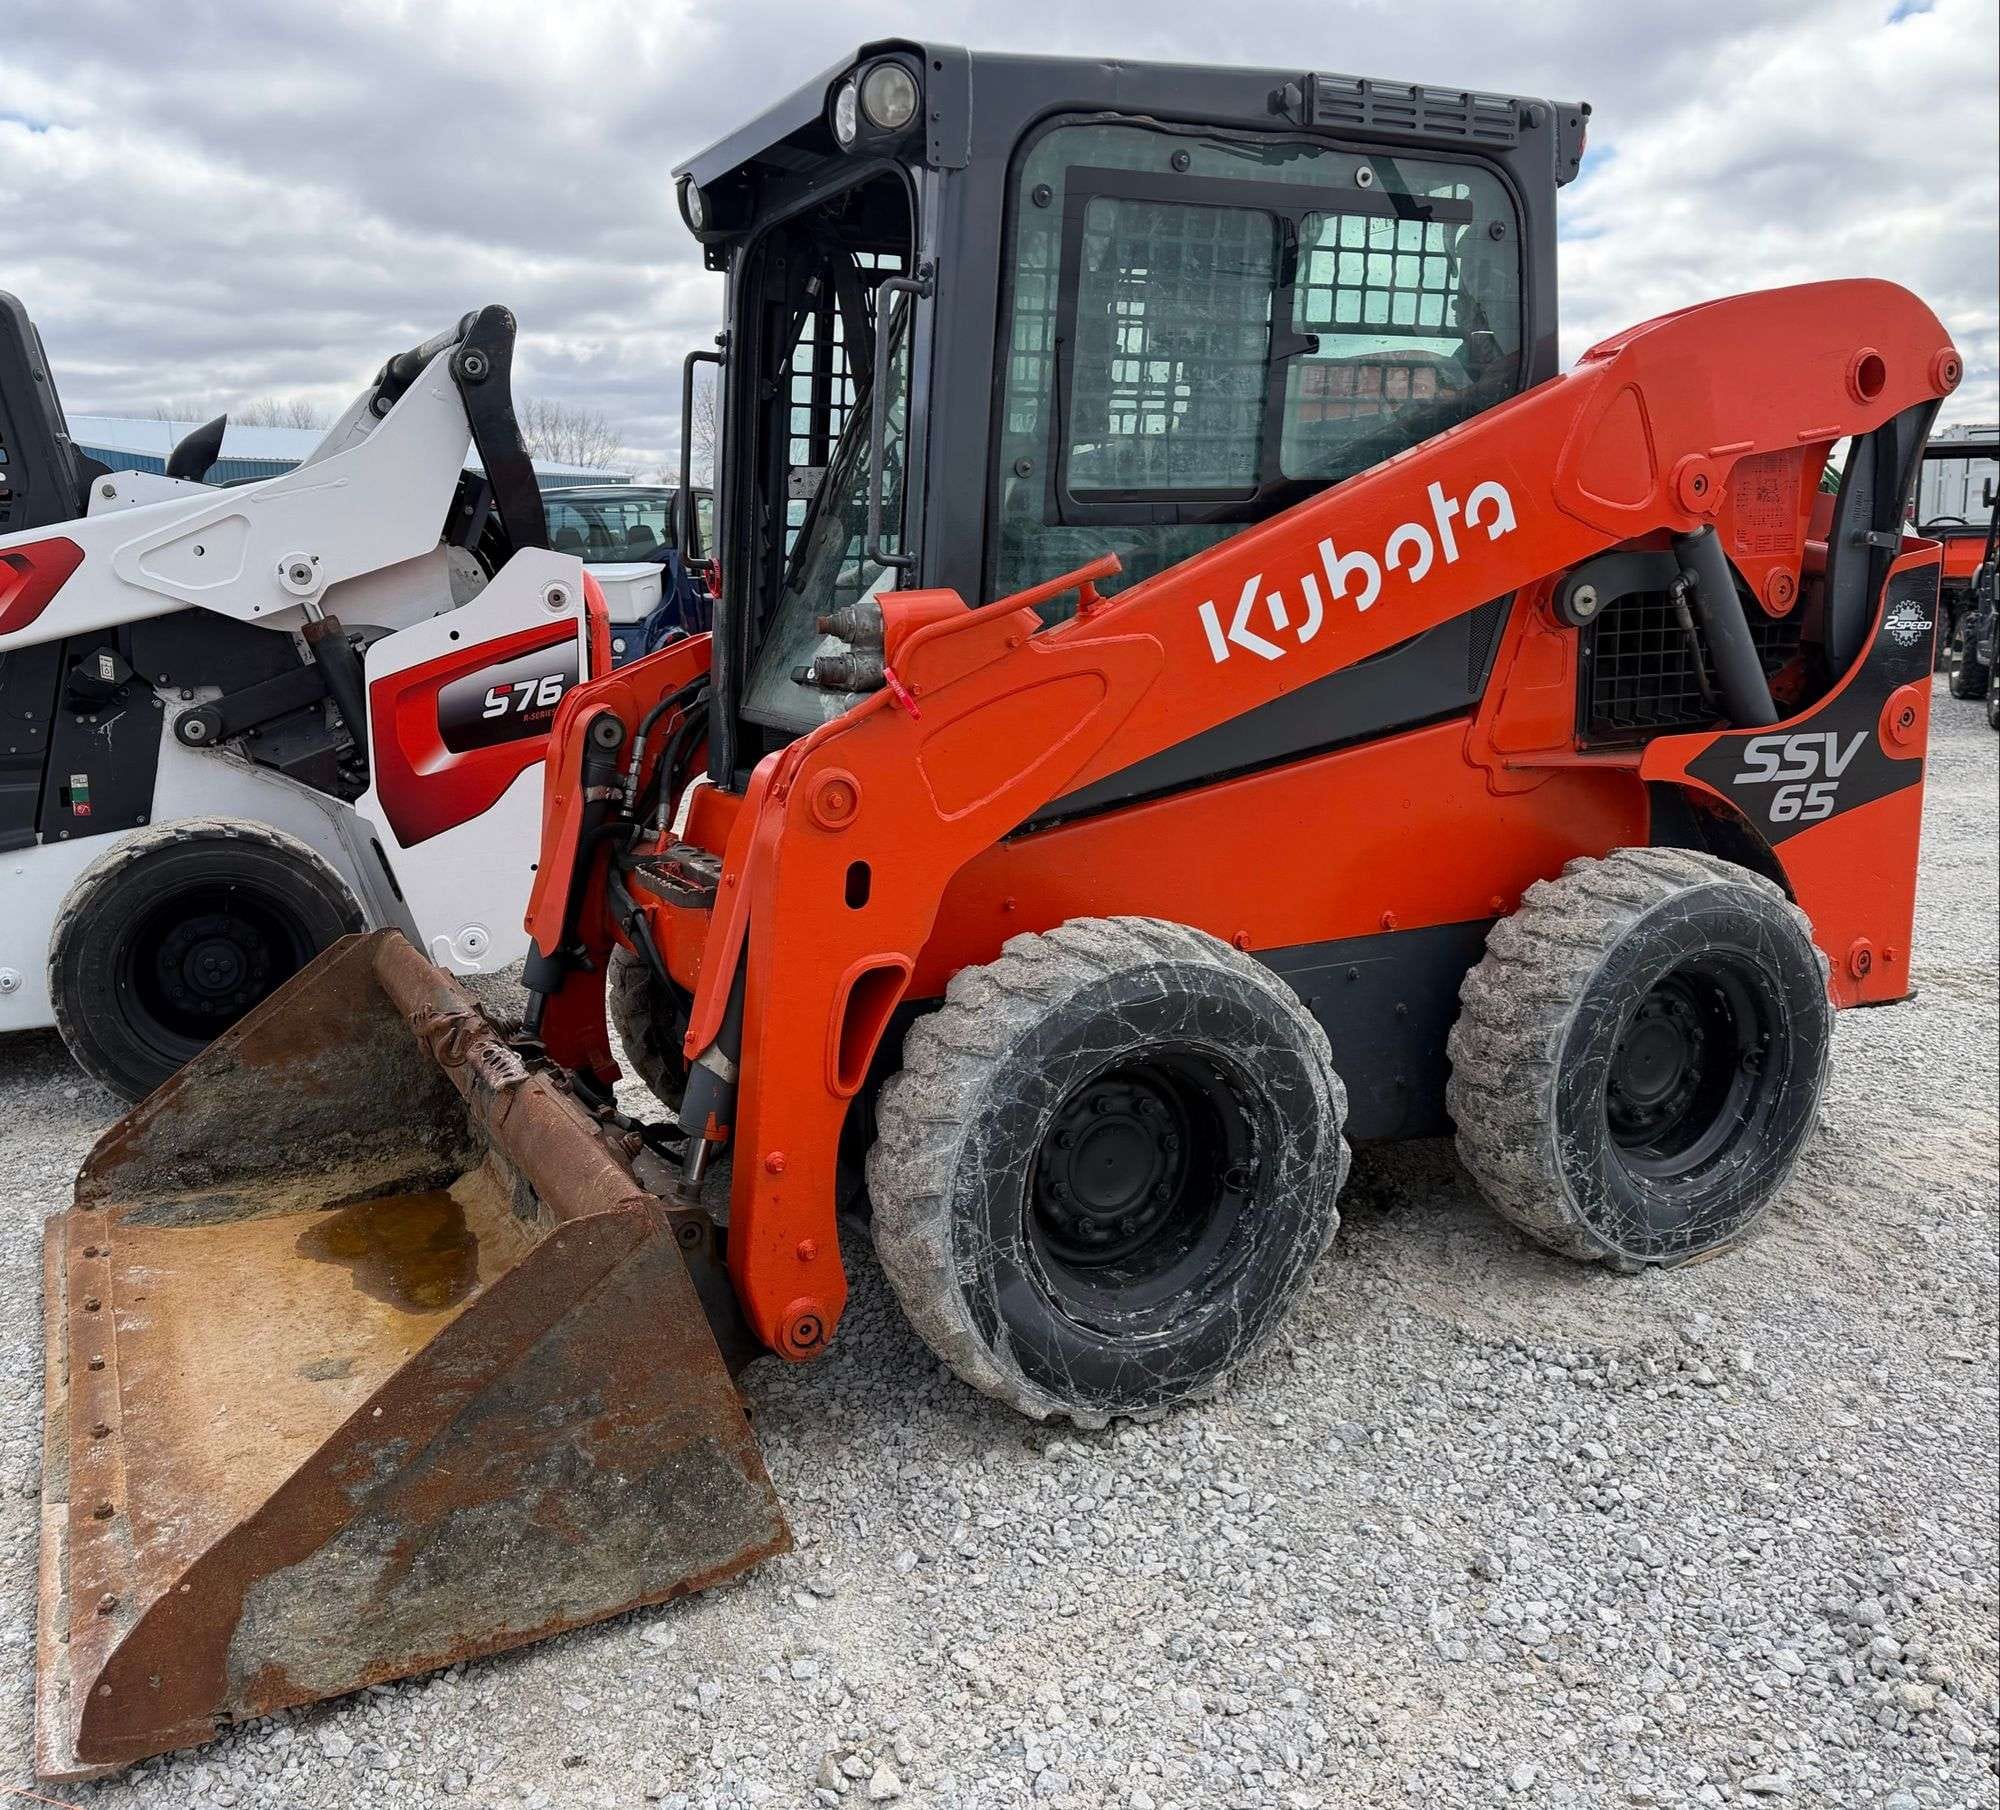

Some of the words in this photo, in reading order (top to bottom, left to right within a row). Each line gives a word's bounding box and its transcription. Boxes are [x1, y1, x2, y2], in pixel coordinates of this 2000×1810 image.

[1198, 480, 1517, 664] Kubota
[482, 673, 565, 719] S76
[1732, 731, 1869, 784] SSV
[1768, 781, 1839, 822] 65
